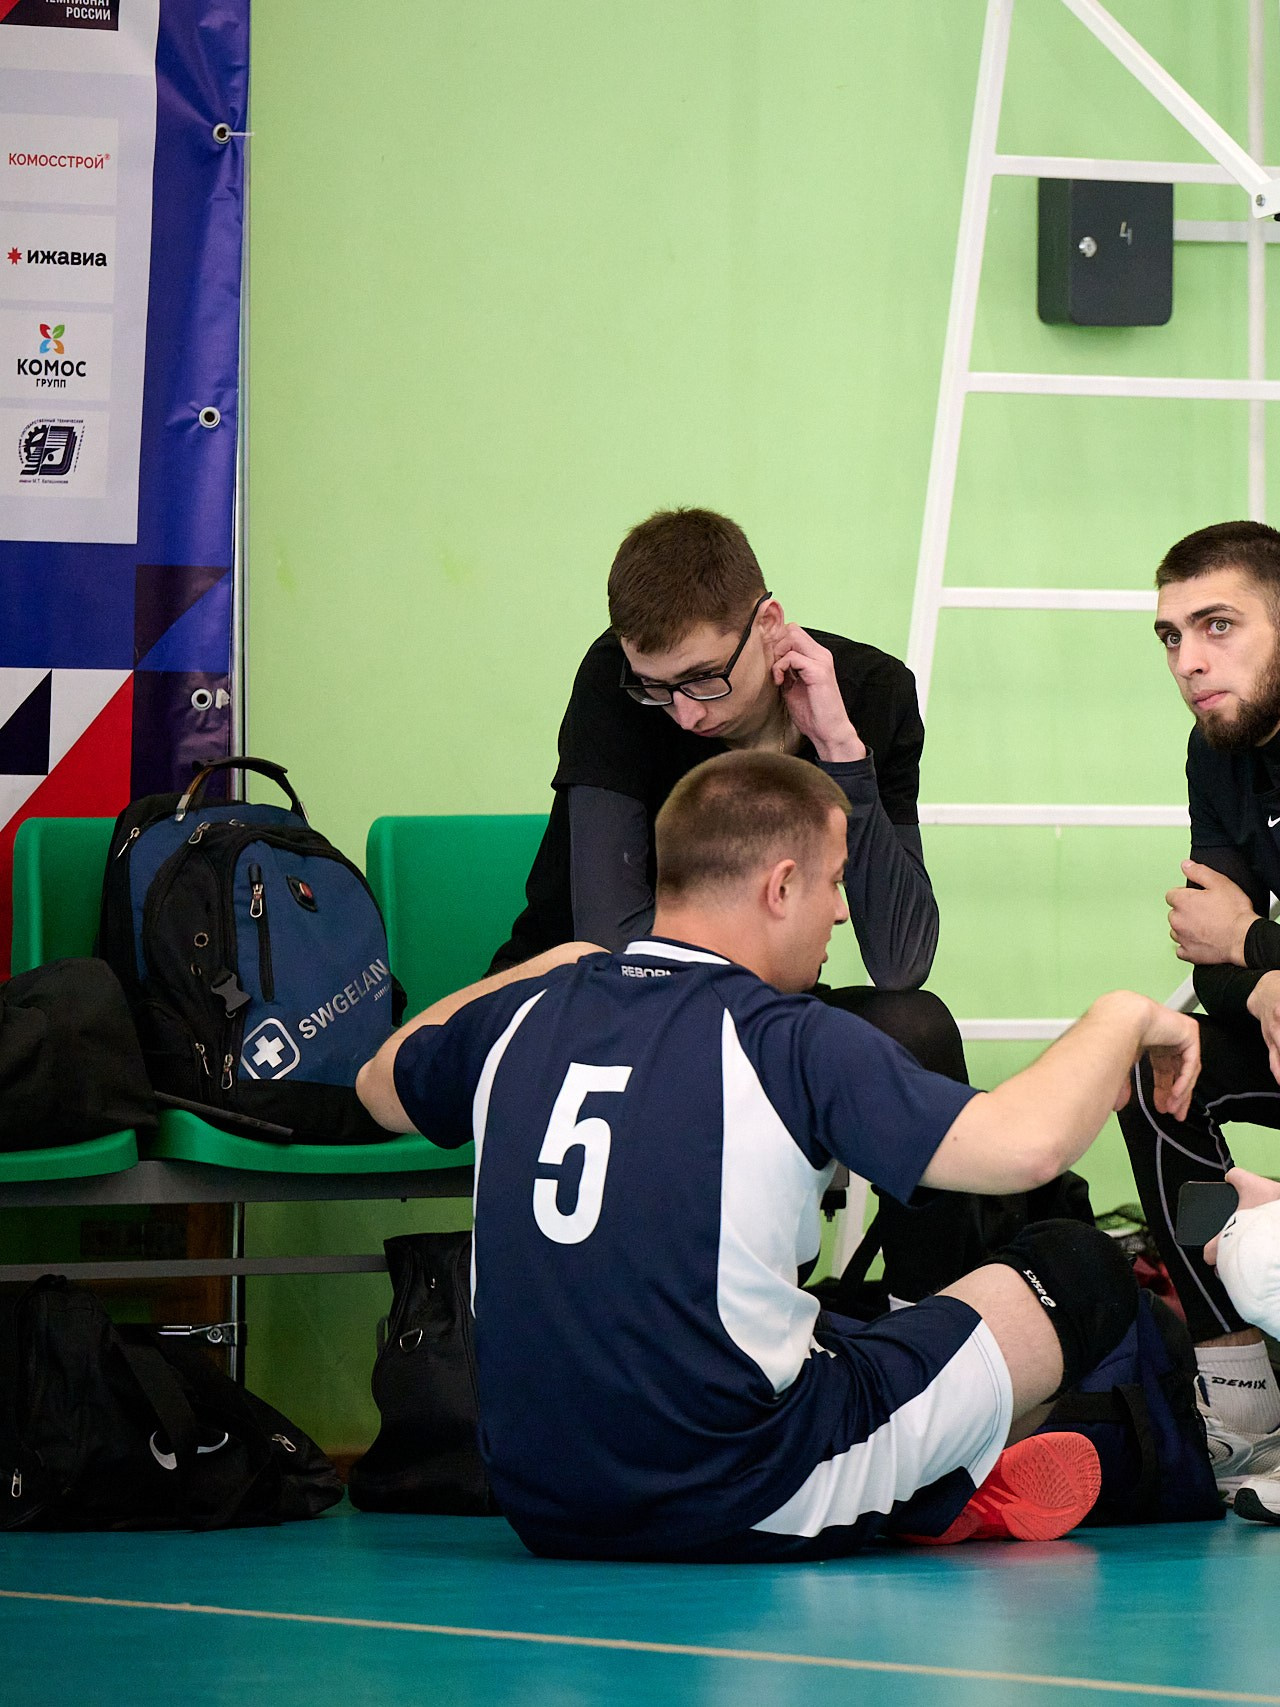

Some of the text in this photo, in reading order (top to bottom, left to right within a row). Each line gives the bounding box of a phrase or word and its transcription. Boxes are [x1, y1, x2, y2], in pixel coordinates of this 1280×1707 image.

[66, 7, 111, 20] РОССИИ
[1119, 221, 1132, 245] 4
[17, 359, 86, 376] КОМОС
[36, 379, 66, 387] ГРУПП
[533, 1062, 633, 1244] 5
[1211, 1376, 1266, 1389] DEMIX
